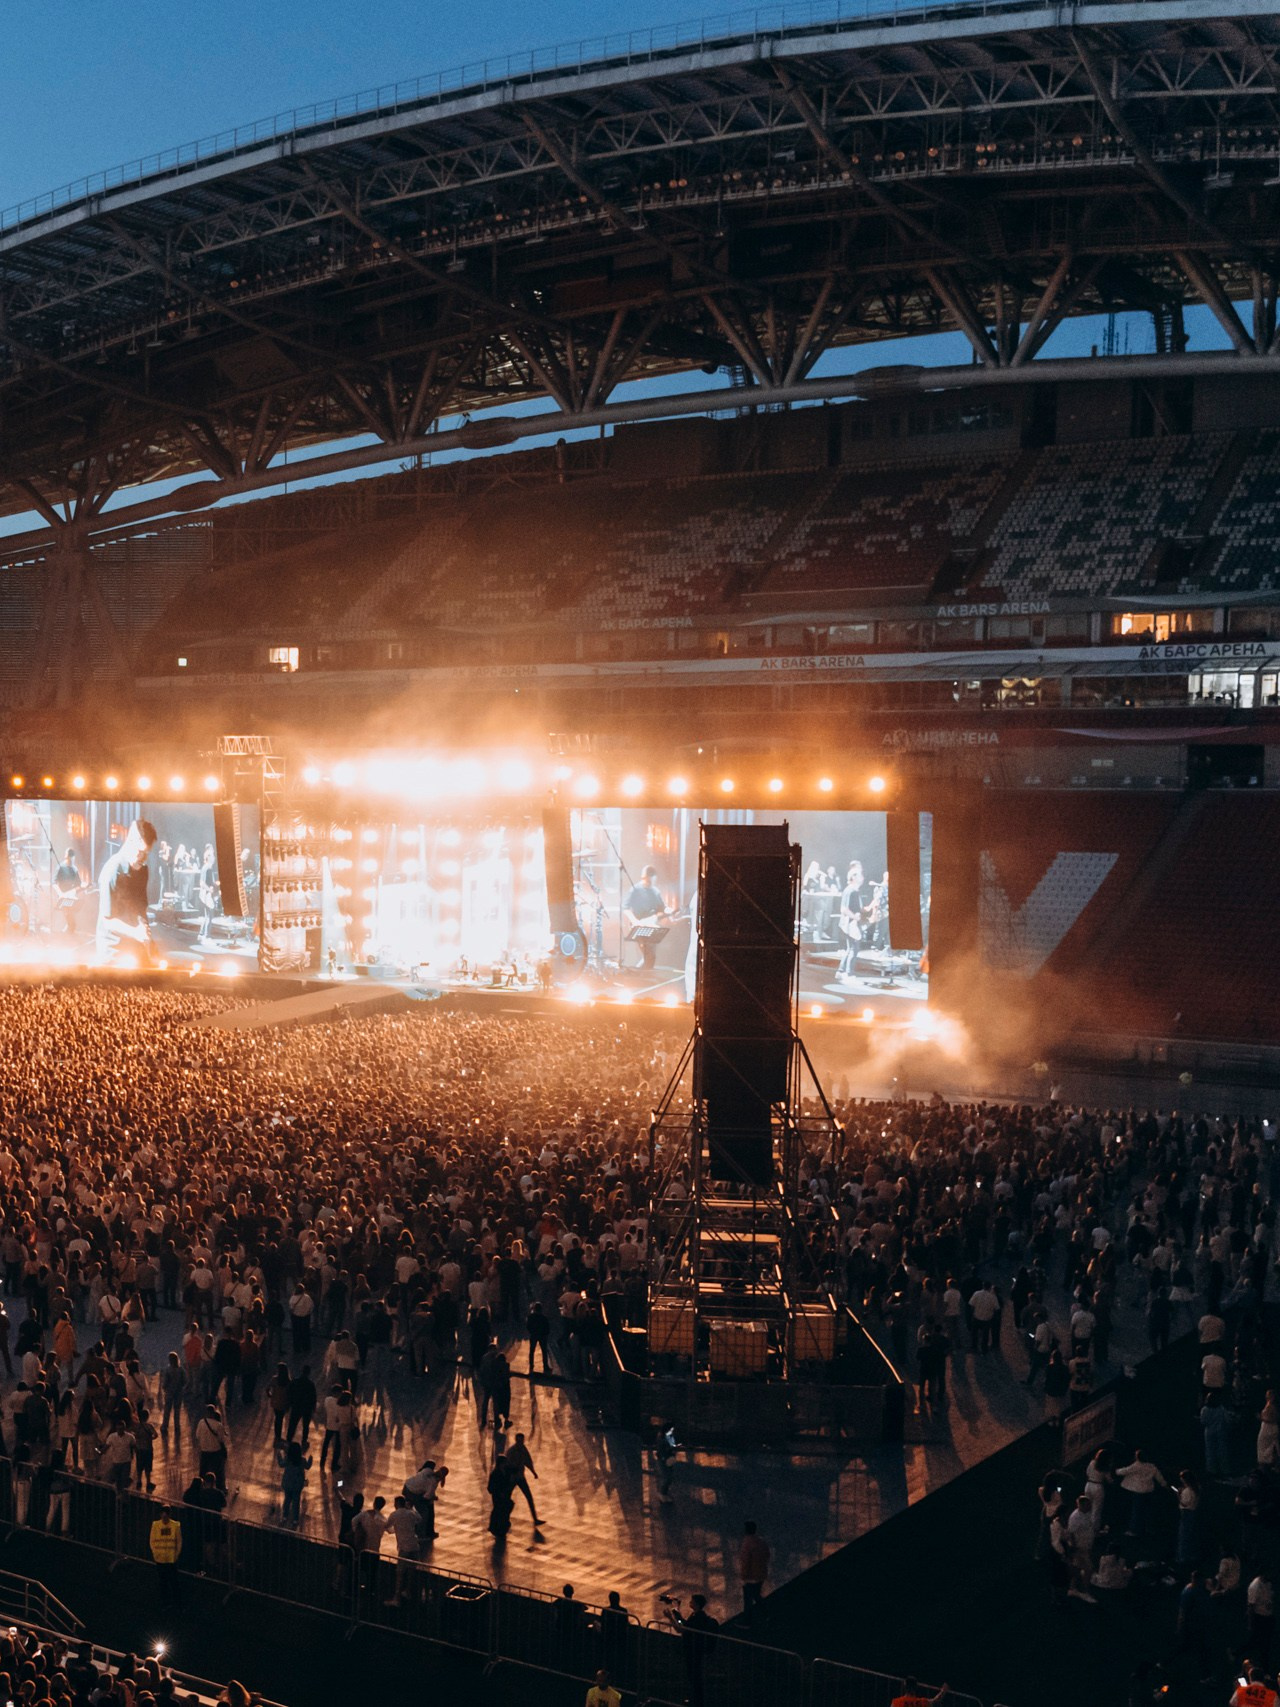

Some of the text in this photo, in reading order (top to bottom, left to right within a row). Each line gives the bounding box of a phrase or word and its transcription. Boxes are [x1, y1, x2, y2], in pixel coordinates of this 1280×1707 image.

[937, 601, 1051, 617] AK BARS ARENA
[618, 618, 650, 630] БАРС
[652, 616, 693, 629] АРЕНА
[1138, 643, 1266, 659] АК БАРС АРЕНА
[761, 656, 865, 669] AK BARS ARENA
